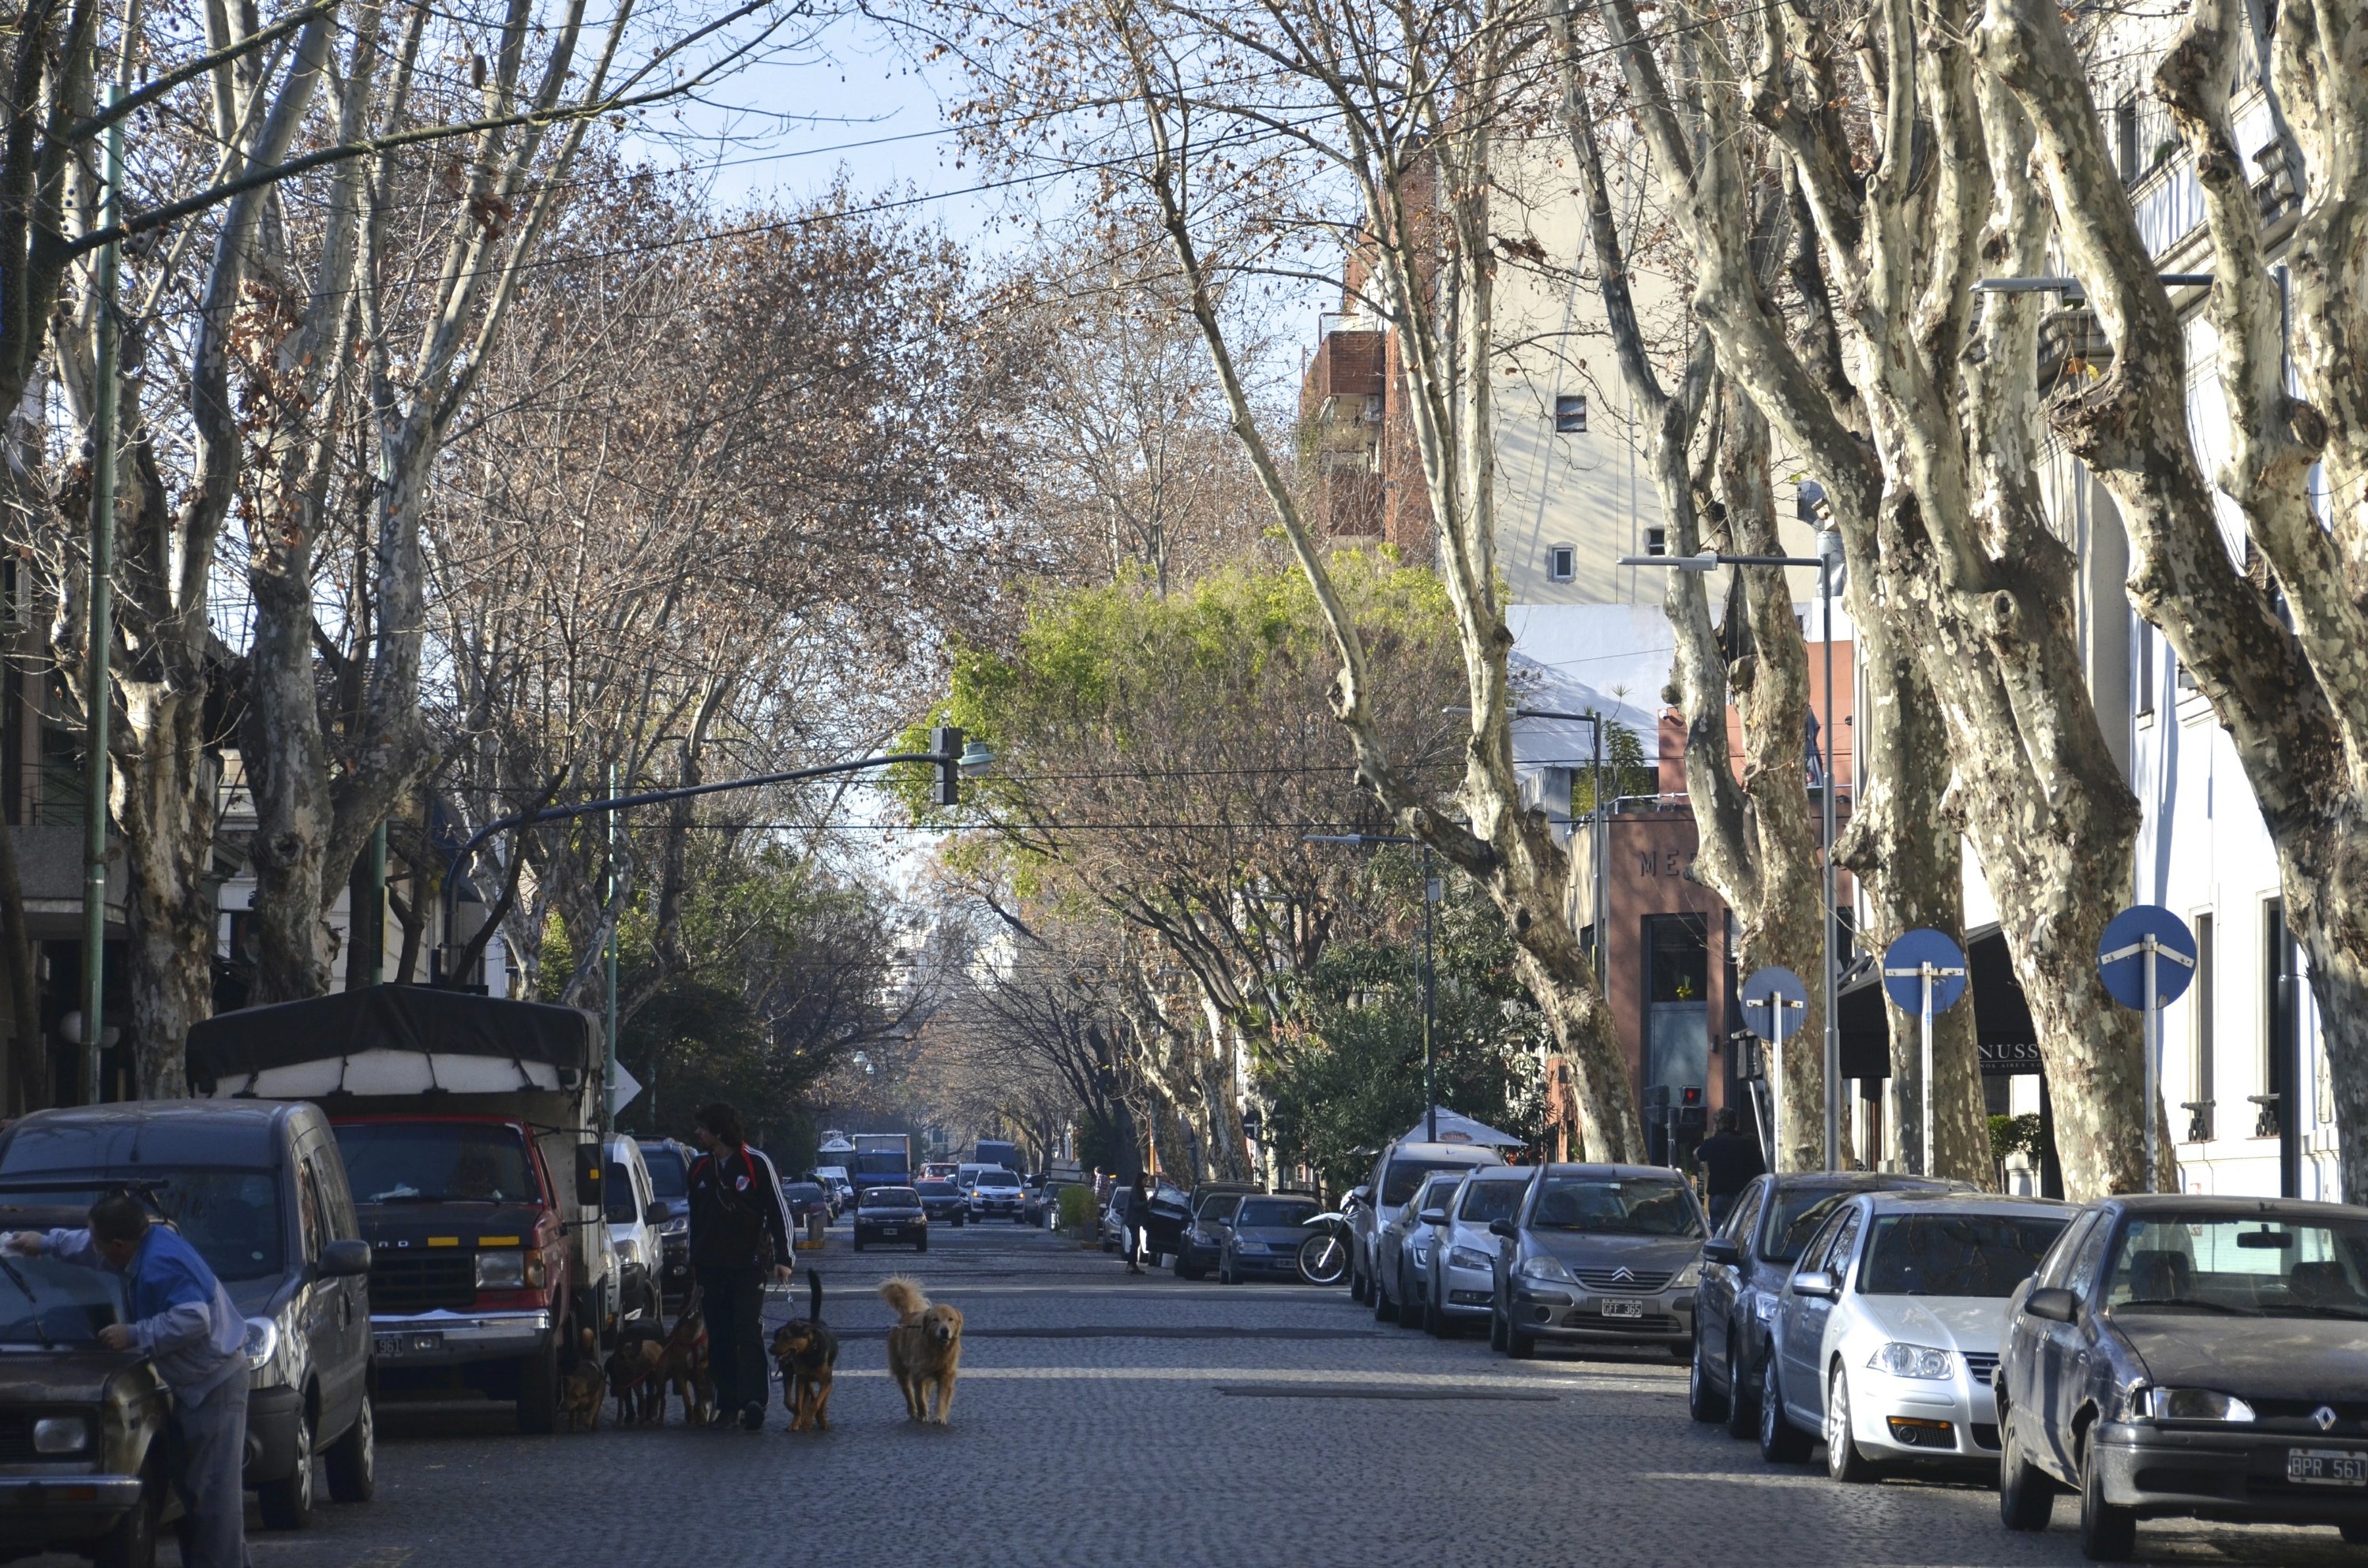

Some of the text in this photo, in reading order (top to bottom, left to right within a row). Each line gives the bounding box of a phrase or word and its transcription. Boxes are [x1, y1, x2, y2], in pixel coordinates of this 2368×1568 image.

[1977, 1043, 2038, 1059] NUSS
[1624, 1304, 1640, 1315] 365
[2291, 1457, 2362, 1480] BPR 561
